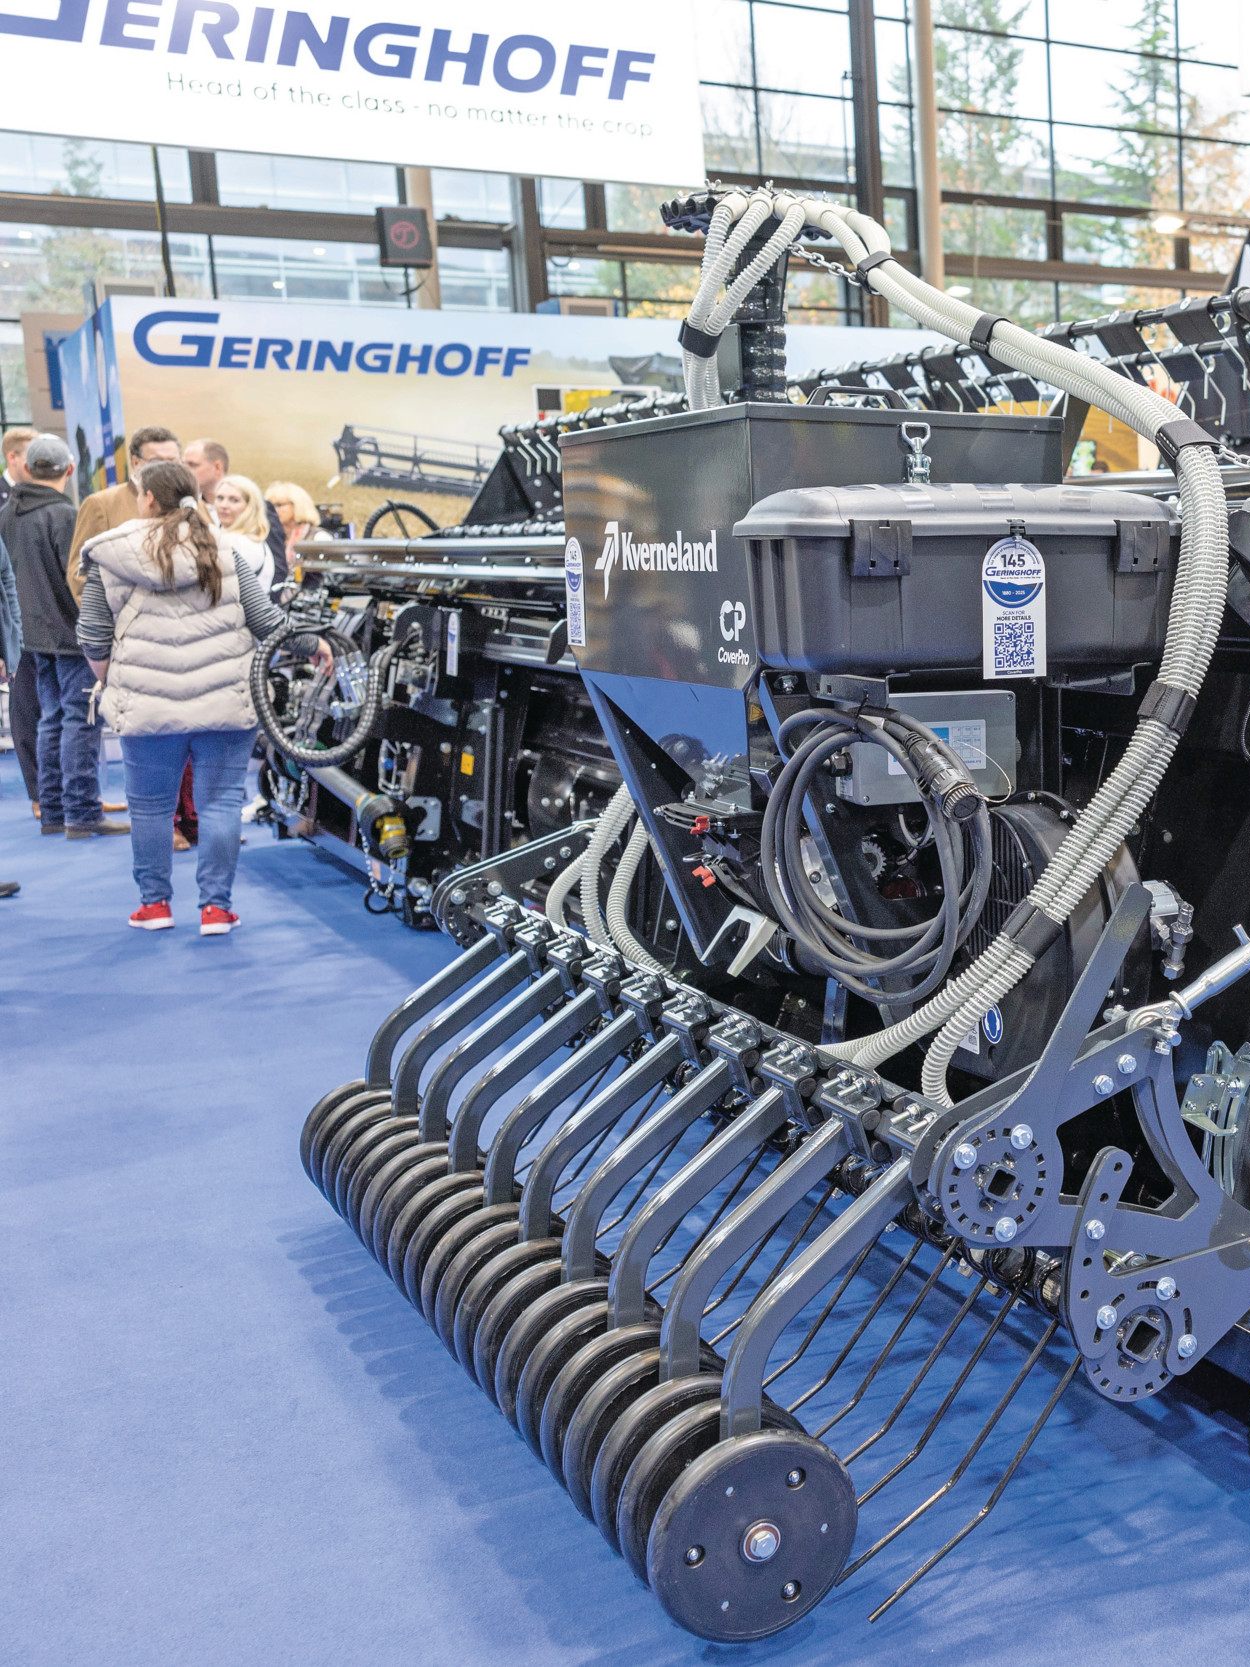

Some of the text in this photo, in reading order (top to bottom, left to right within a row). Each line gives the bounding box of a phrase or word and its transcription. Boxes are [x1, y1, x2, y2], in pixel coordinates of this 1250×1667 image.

[167, 71, 242, 97] Head
[253, 82, 278, 101] of
[289, 85, 331, 107] the
[342, 91, 405, 114] class
[428, 101, 458, 119] no
[468, 105, 548, 127] matter
[558, 113, 594, 132] the
[602, 118, 653, 138] crop
[133, 311, 531, 377] GERINGHOFF
[622, 530, 718, 572] Kverneland
[985, 566, 1042, 576] GERINGHOFF
[1001, 553, 1026, 568] 145
[719, 600, 747, 642] CP
[718, 646, 750, 666] CoverPro
